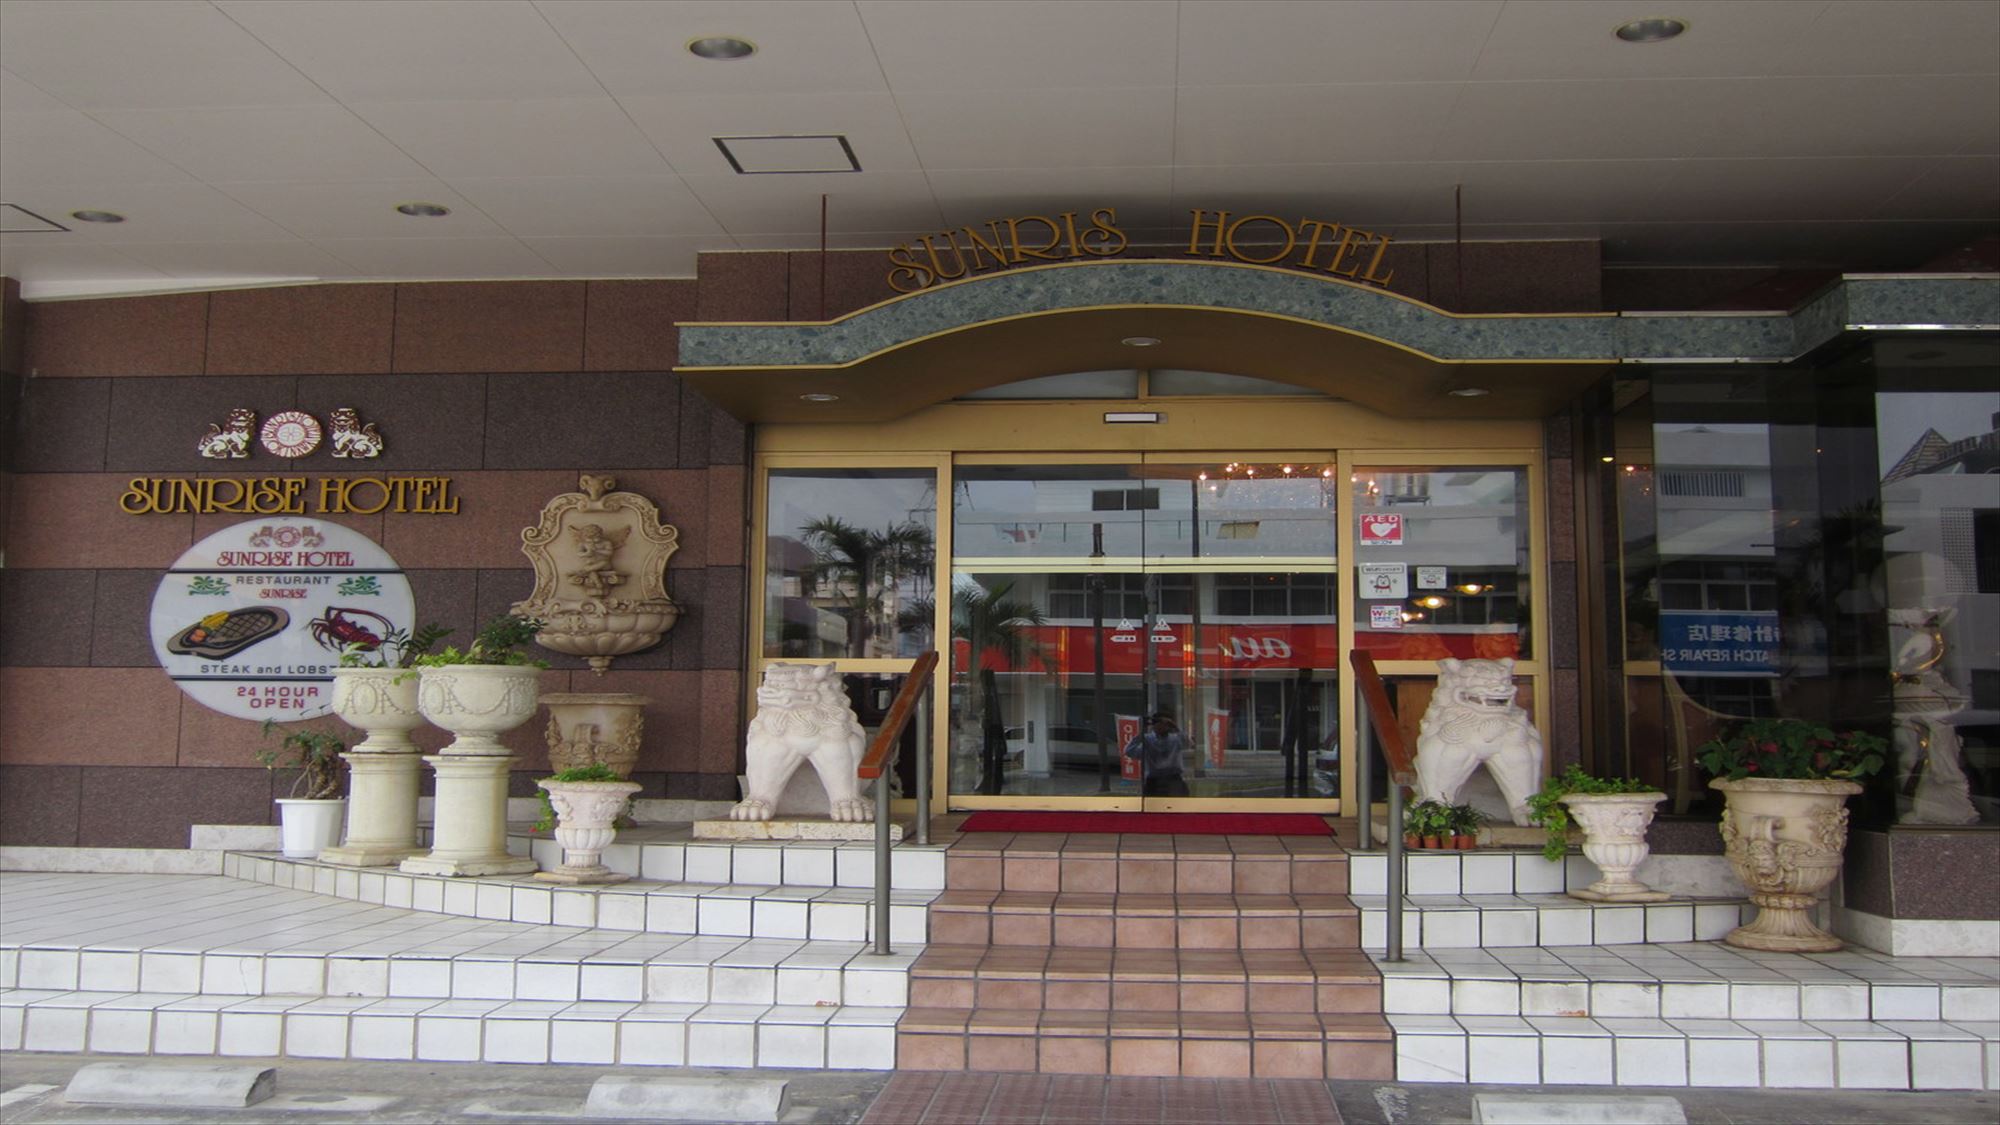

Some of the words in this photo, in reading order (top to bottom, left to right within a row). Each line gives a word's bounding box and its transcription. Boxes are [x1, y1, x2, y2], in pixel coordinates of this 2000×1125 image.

[887, 207, 1127, 293] SUNRIS
[1186, 208, 1395, 287] HOTEL
[120, 477, 306, 514] SUNRISE
[315, 477, 460, 514] HOTEL
[1364, 515, 1399, 523] AED
[217, 551, 293, 567] SUNRISE
[297, 551, 354, 567] HOTEL
[236, 575, 332, 585] RESTAURANT
[259, 588, 308, 599] SUNRISE
[201, 664, 250, 674] STEAK
[257, 664, 281, 674] and
[288, 665, 352, 674] LOBS
[237, 686, 257, 697] 24
[265, 686, 319, 697] HOUR
[250, 698, 305, 709] OPEN
